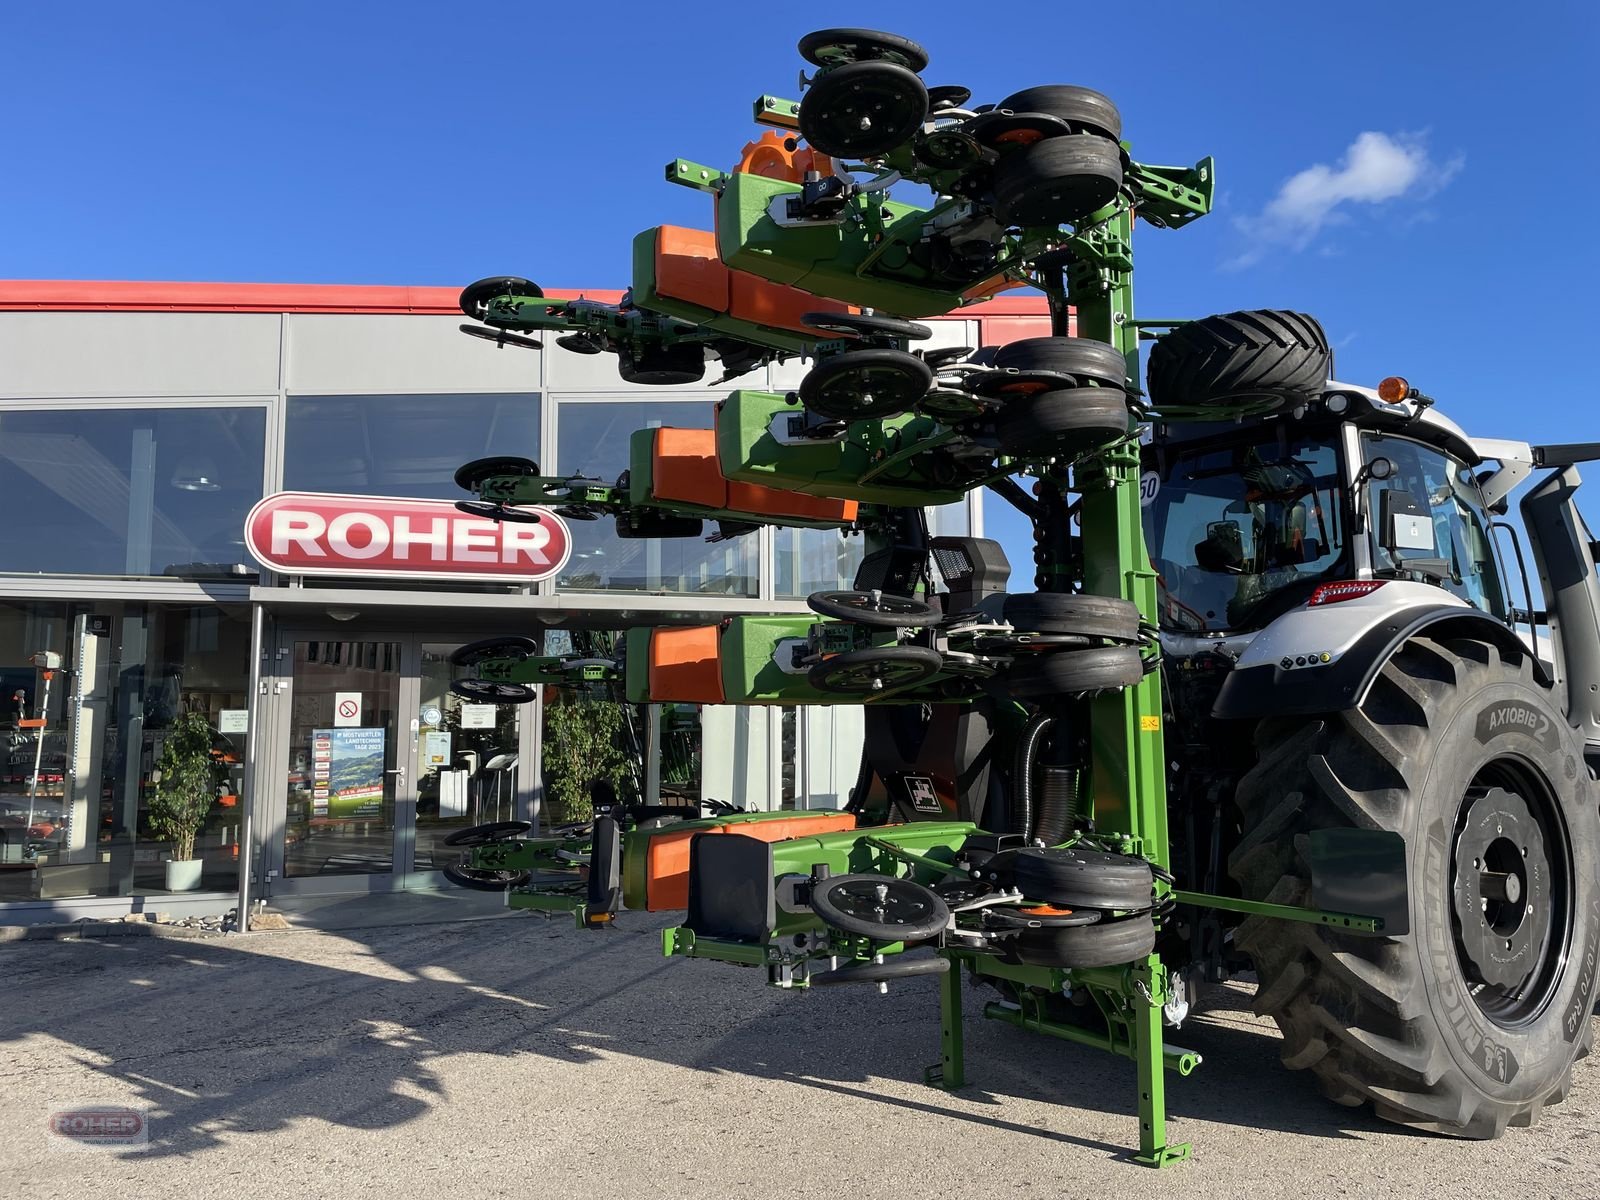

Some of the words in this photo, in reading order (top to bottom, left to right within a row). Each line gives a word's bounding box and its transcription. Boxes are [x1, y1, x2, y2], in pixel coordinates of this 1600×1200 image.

[270, 509, 551, 565] ROHER
[1489, 706, 1538, 730] AXIOBIB
[1533, 714, 1550, 742] 2
[1426, 838, 1483, 1056] MICHELIN
[1567, 997, 1583, 1033] R42
